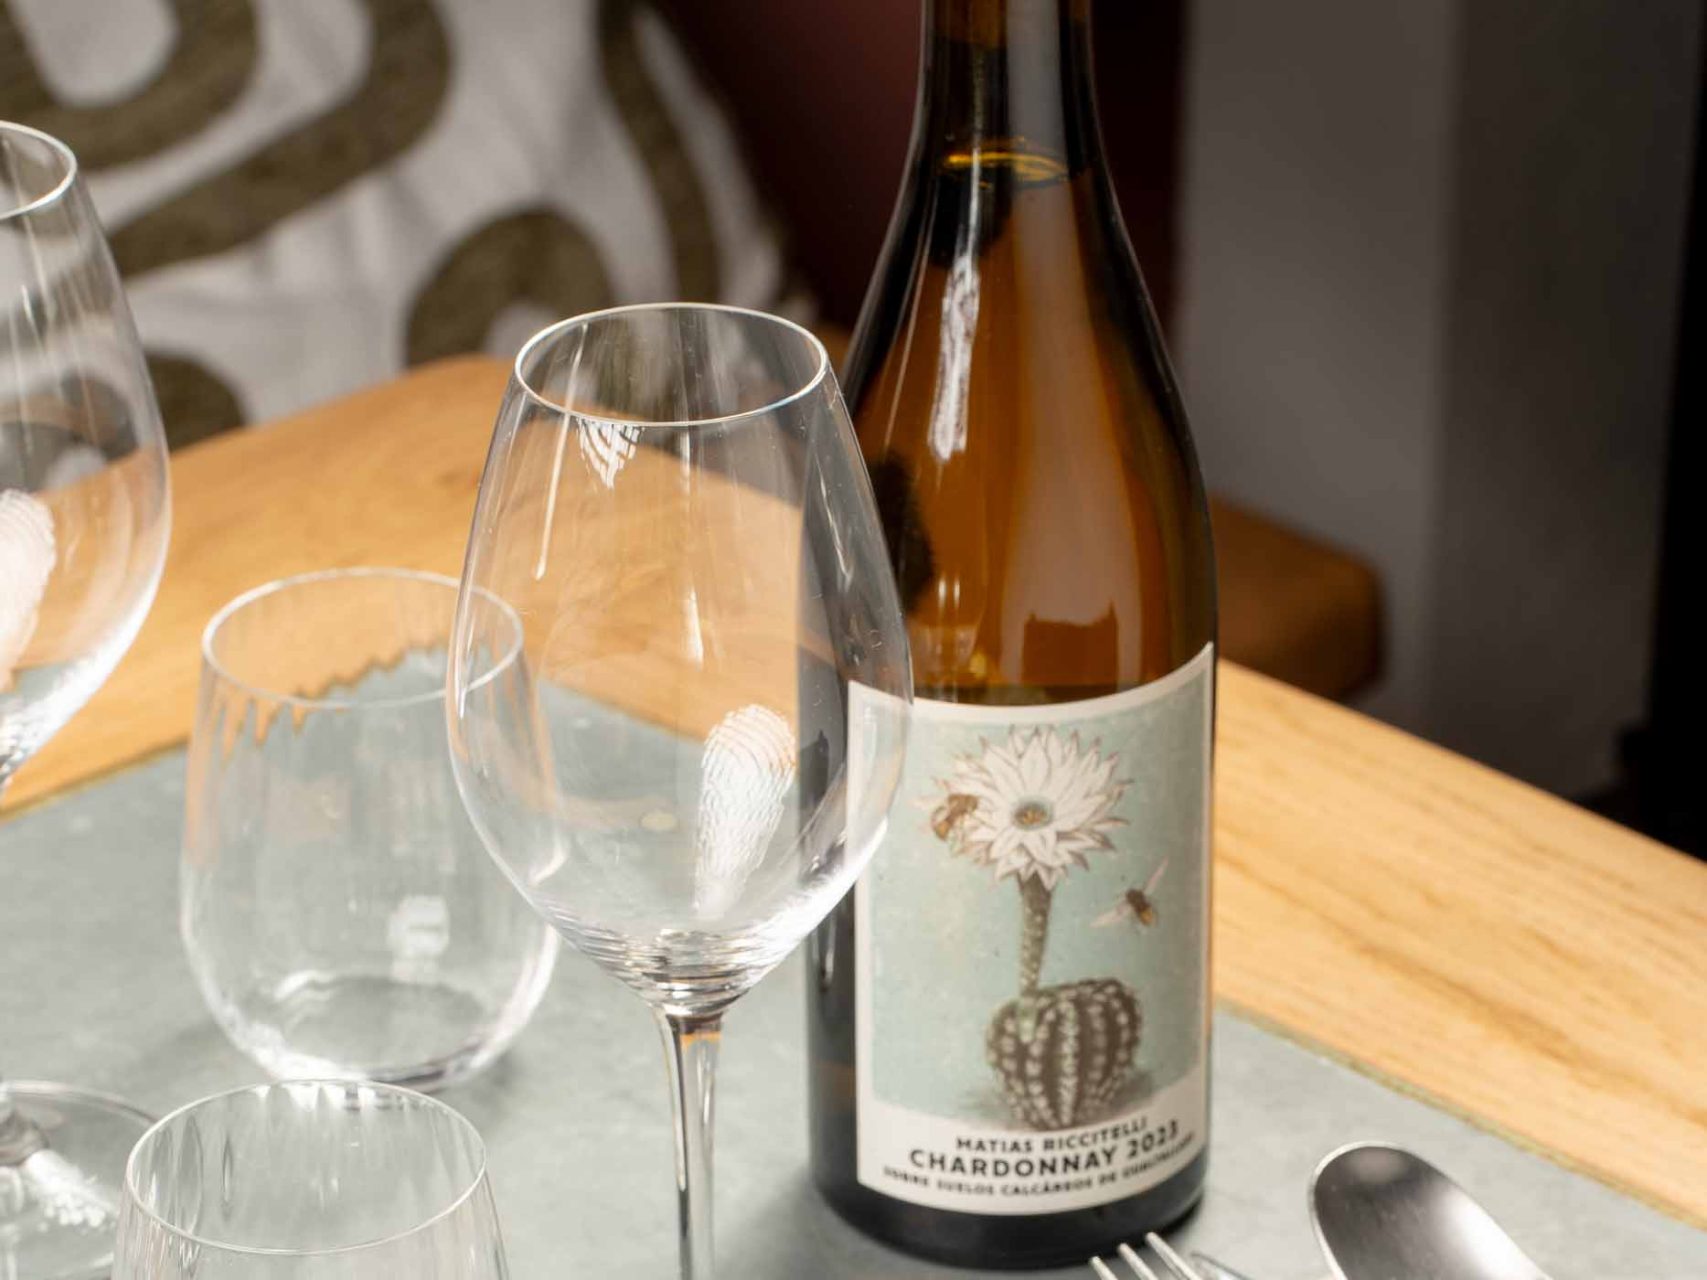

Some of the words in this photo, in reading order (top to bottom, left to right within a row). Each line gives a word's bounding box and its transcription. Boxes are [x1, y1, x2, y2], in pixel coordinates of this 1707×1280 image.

[910, 1146, 1117, 1177] CHARDONNAY
[1127, 1119, 1178, 1158] 2023
[957, 1138, 1033, 1153] MATIAS
[1043, 1116, 1147, 1151] RICCITELLI
